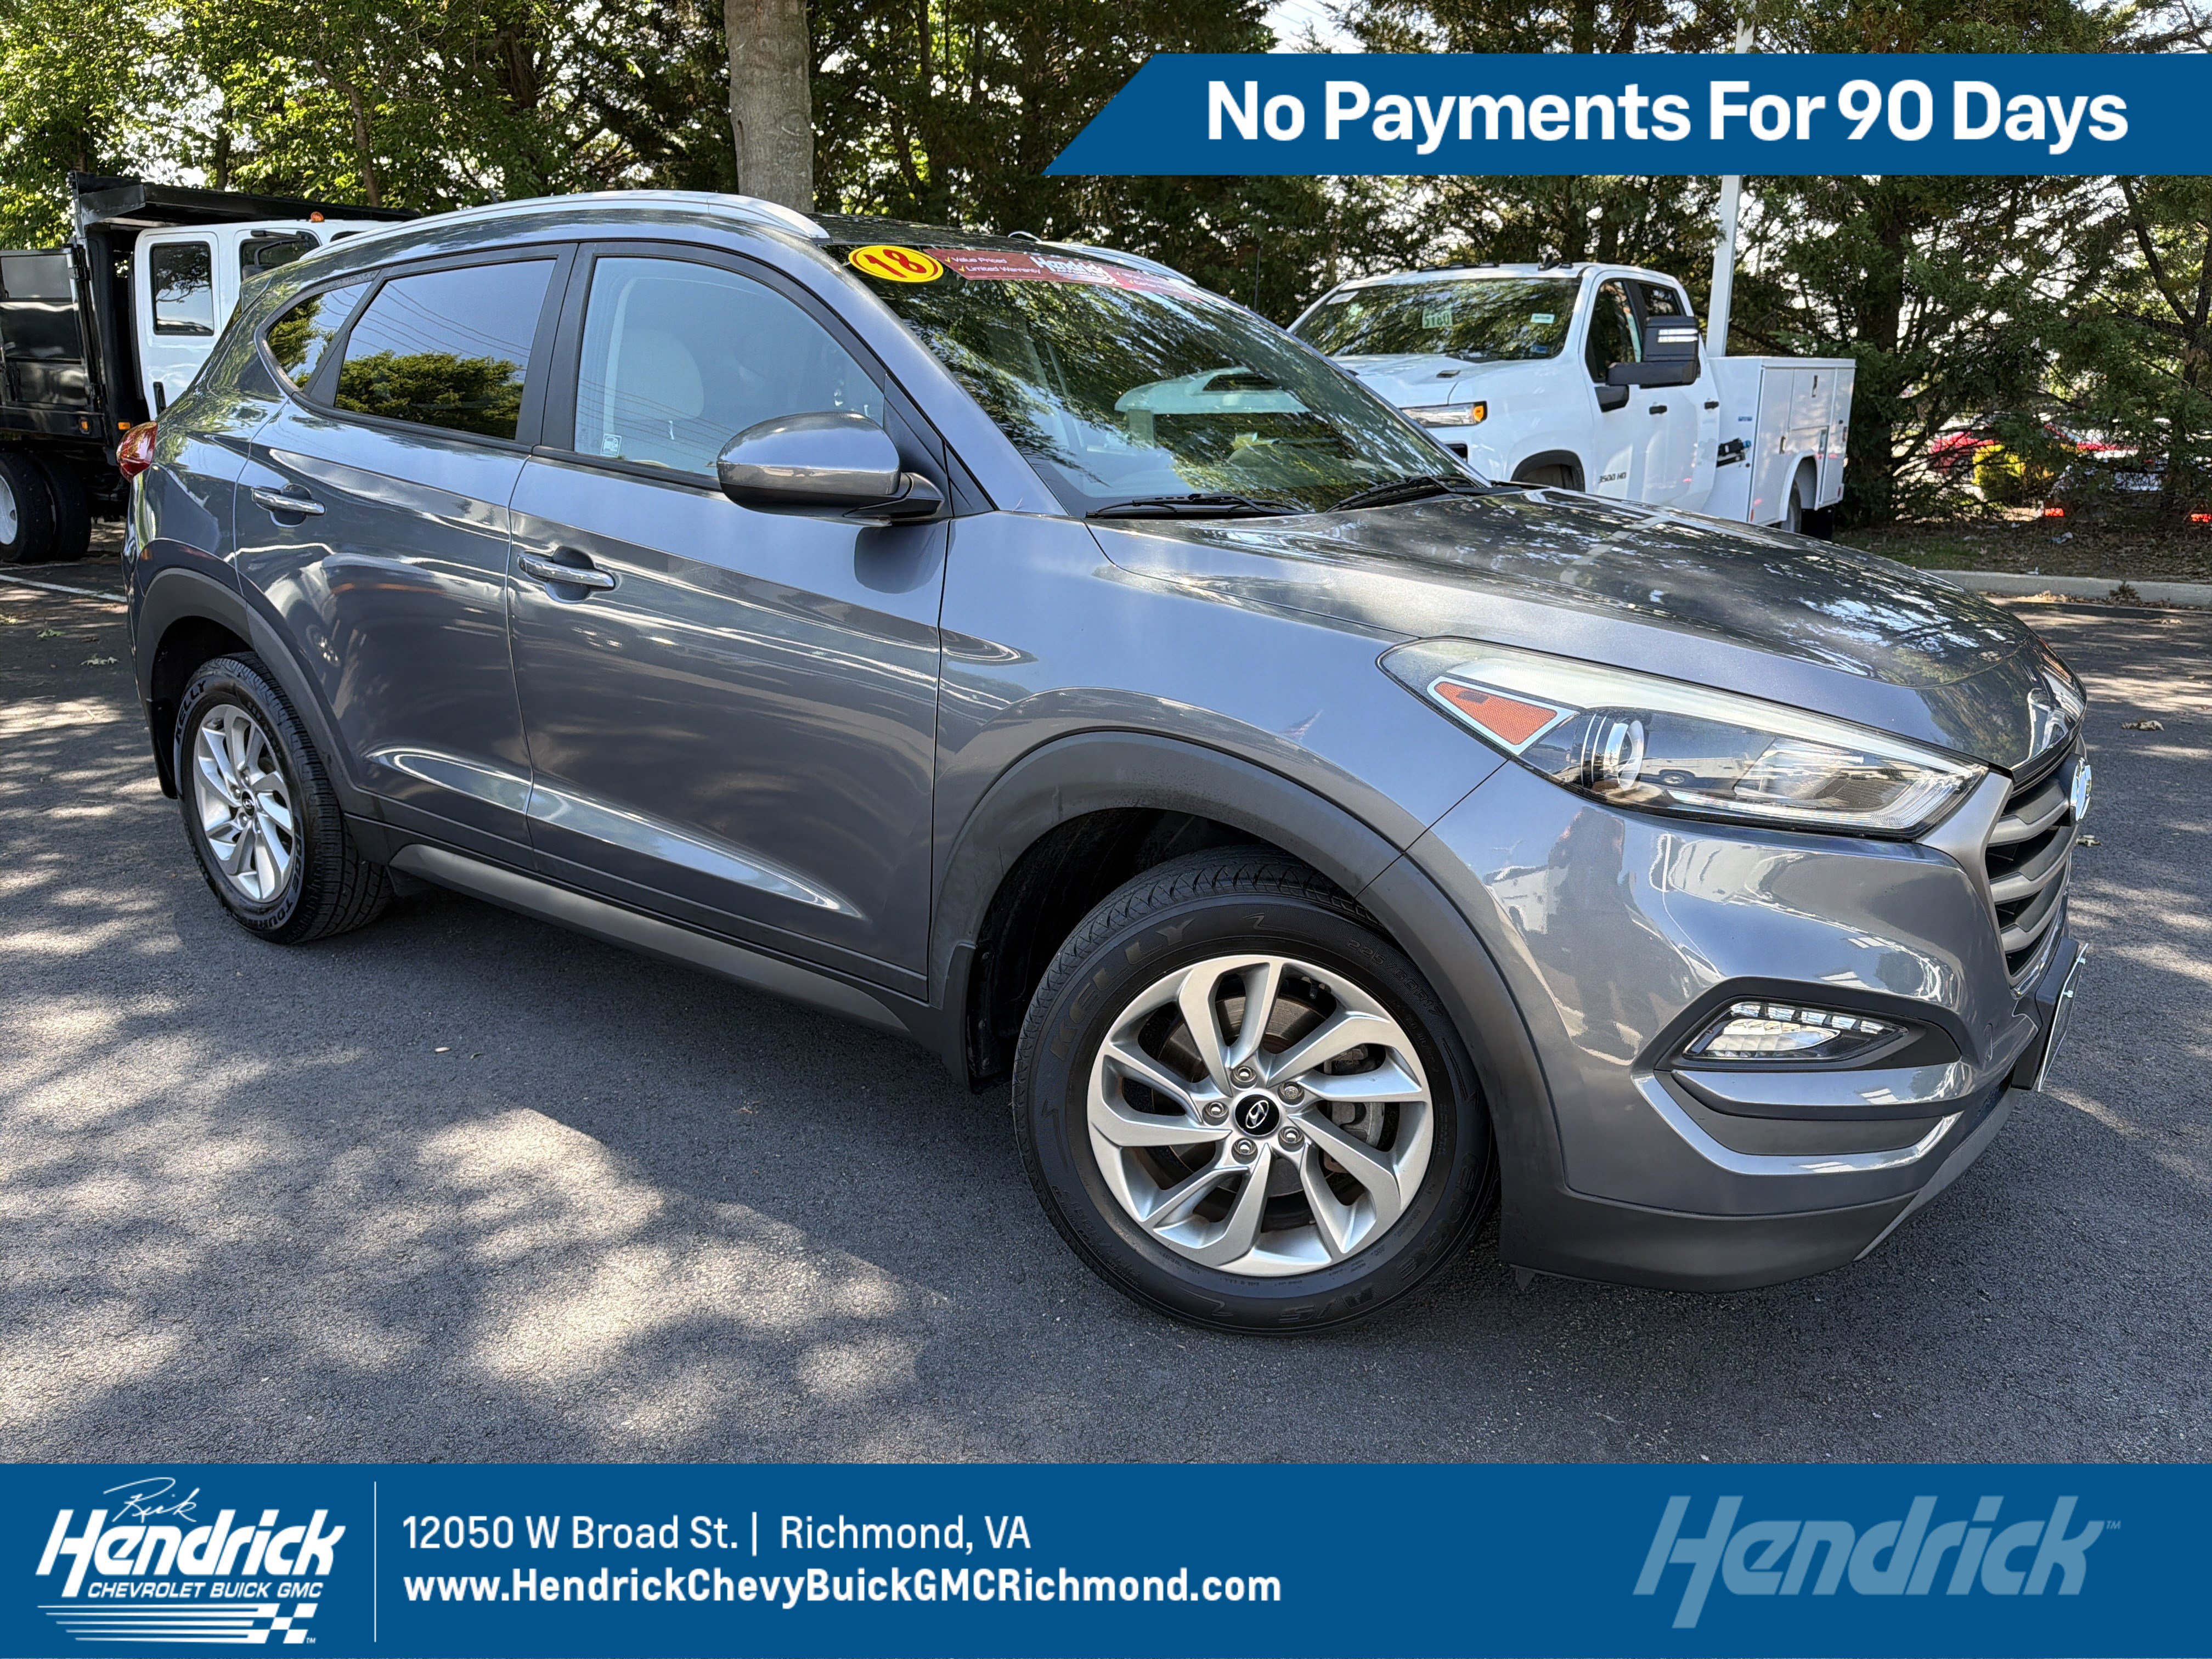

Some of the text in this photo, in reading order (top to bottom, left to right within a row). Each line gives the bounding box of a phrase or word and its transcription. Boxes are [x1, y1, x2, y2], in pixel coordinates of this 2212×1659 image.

[863, 249, 928, 278] 18
[1029, 256, 1117, 283] Hendrick
[175, 680, 206, 744] KELLY
[1049, 917, 1197, 1062] KELLY
